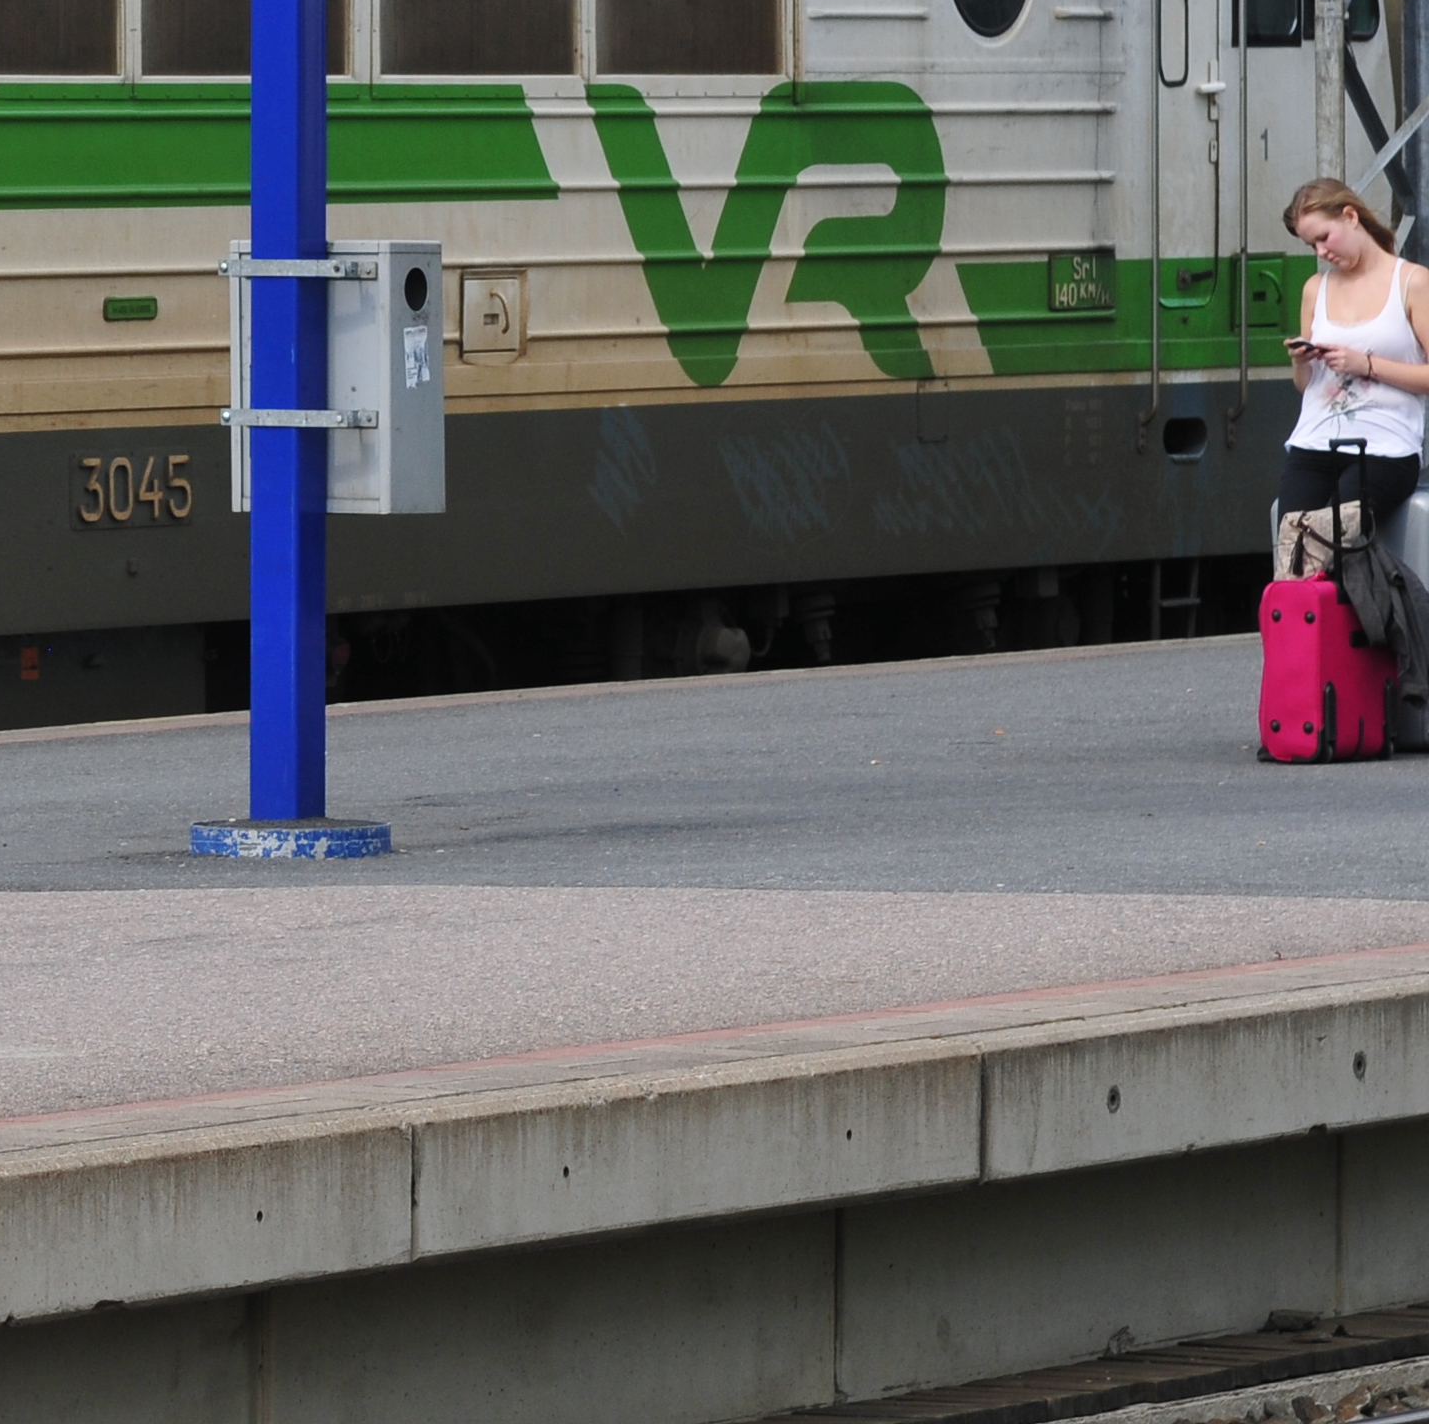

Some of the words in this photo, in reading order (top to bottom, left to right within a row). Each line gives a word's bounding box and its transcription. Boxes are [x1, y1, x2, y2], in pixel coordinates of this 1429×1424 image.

[1260, 128, 1268, 161] 1
[586, 81, 947, 388] VR
[1055, 282, 1077, 308] 140
[79, 454, 194, 524] 3045
